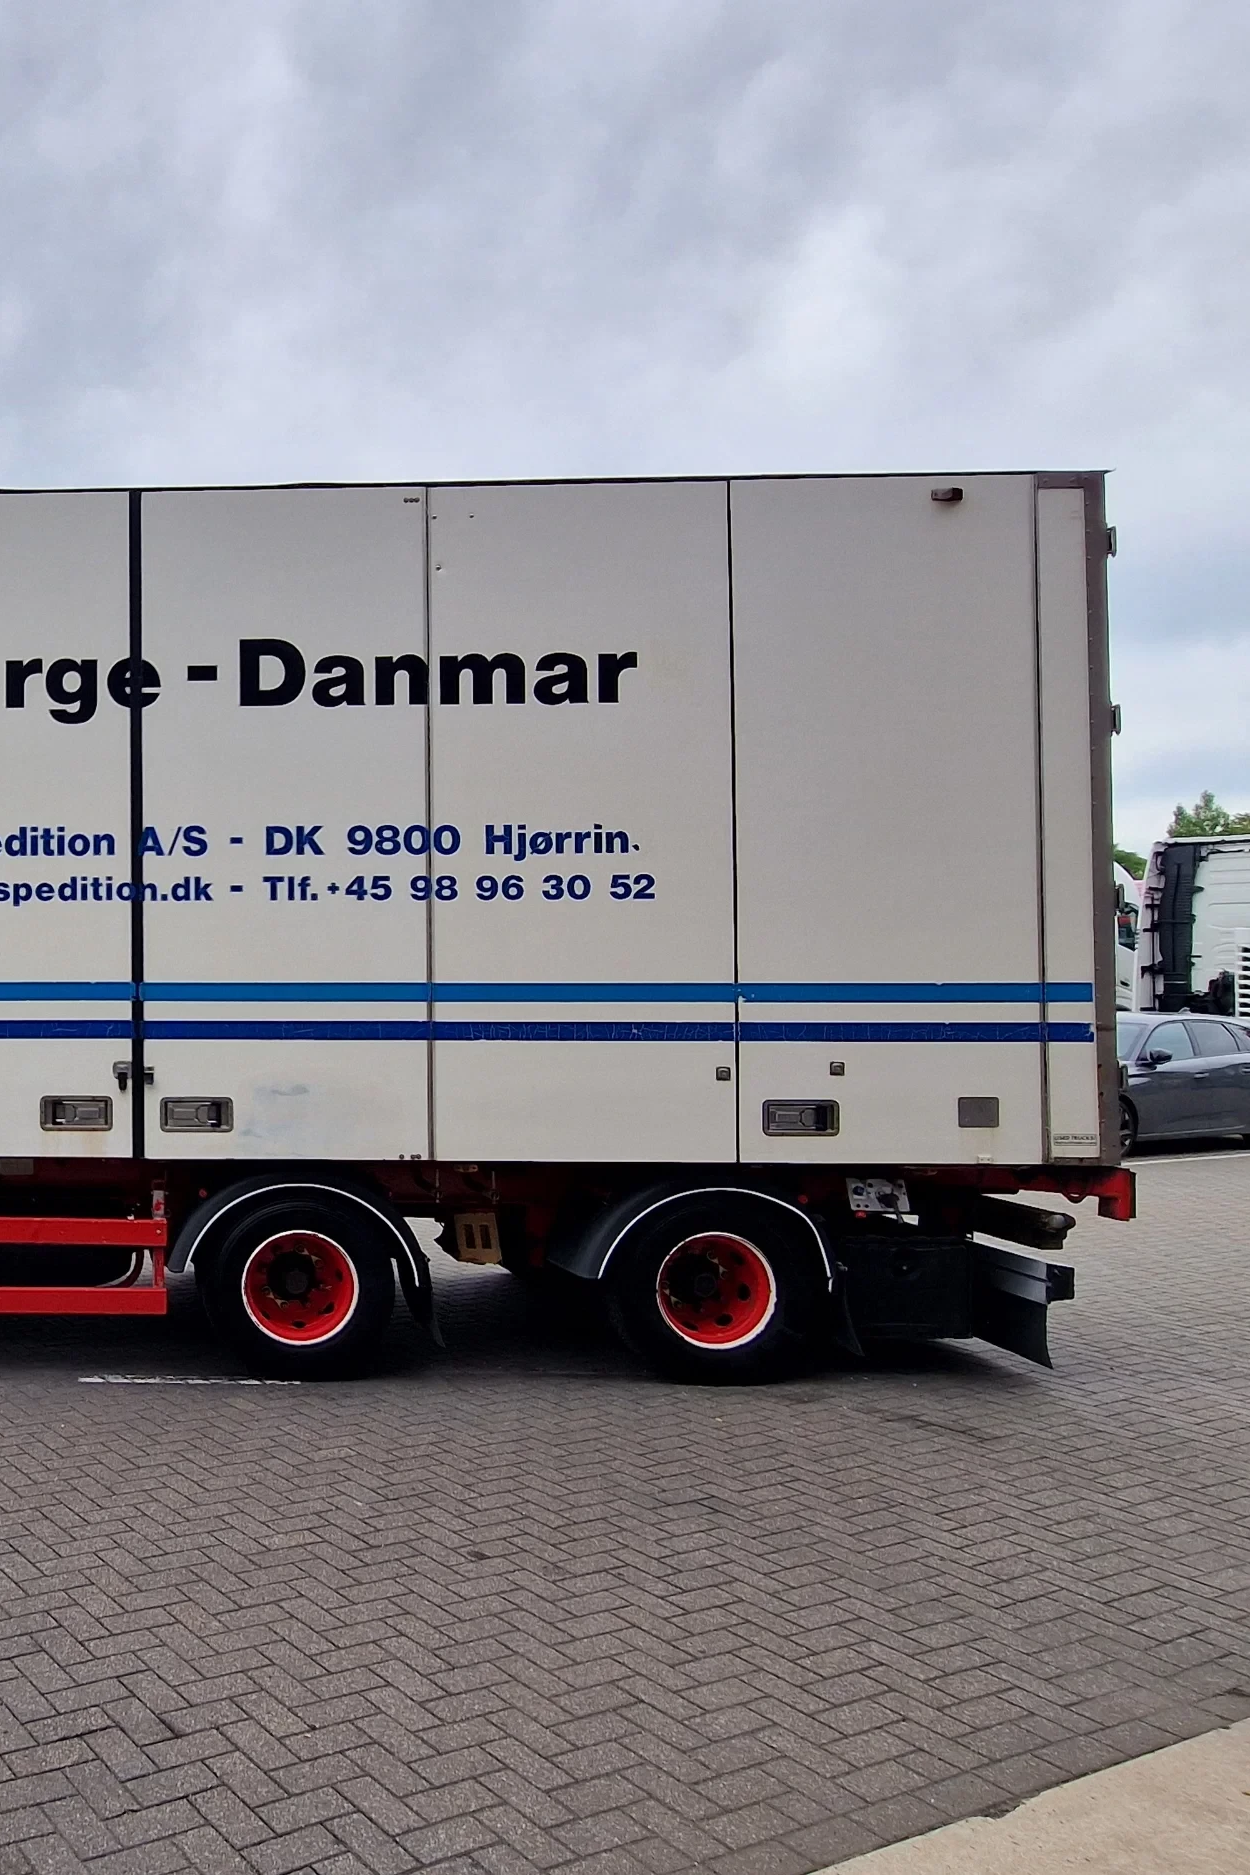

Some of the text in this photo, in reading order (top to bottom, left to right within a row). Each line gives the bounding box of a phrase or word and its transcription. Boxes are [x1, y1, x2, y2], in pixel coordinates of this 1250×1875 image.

[239, 638, 638, 708] Danmar
[137, 825, 208, 857] A/S
[265, 825, 325, 856] DK
[346, 824, 461, 856] 9800
[410, 875, 459, 901] 98
[475, 875, 525, 901] 96
[541, 874, 592, 901] 30
[609, 873, 656, 900] 52
